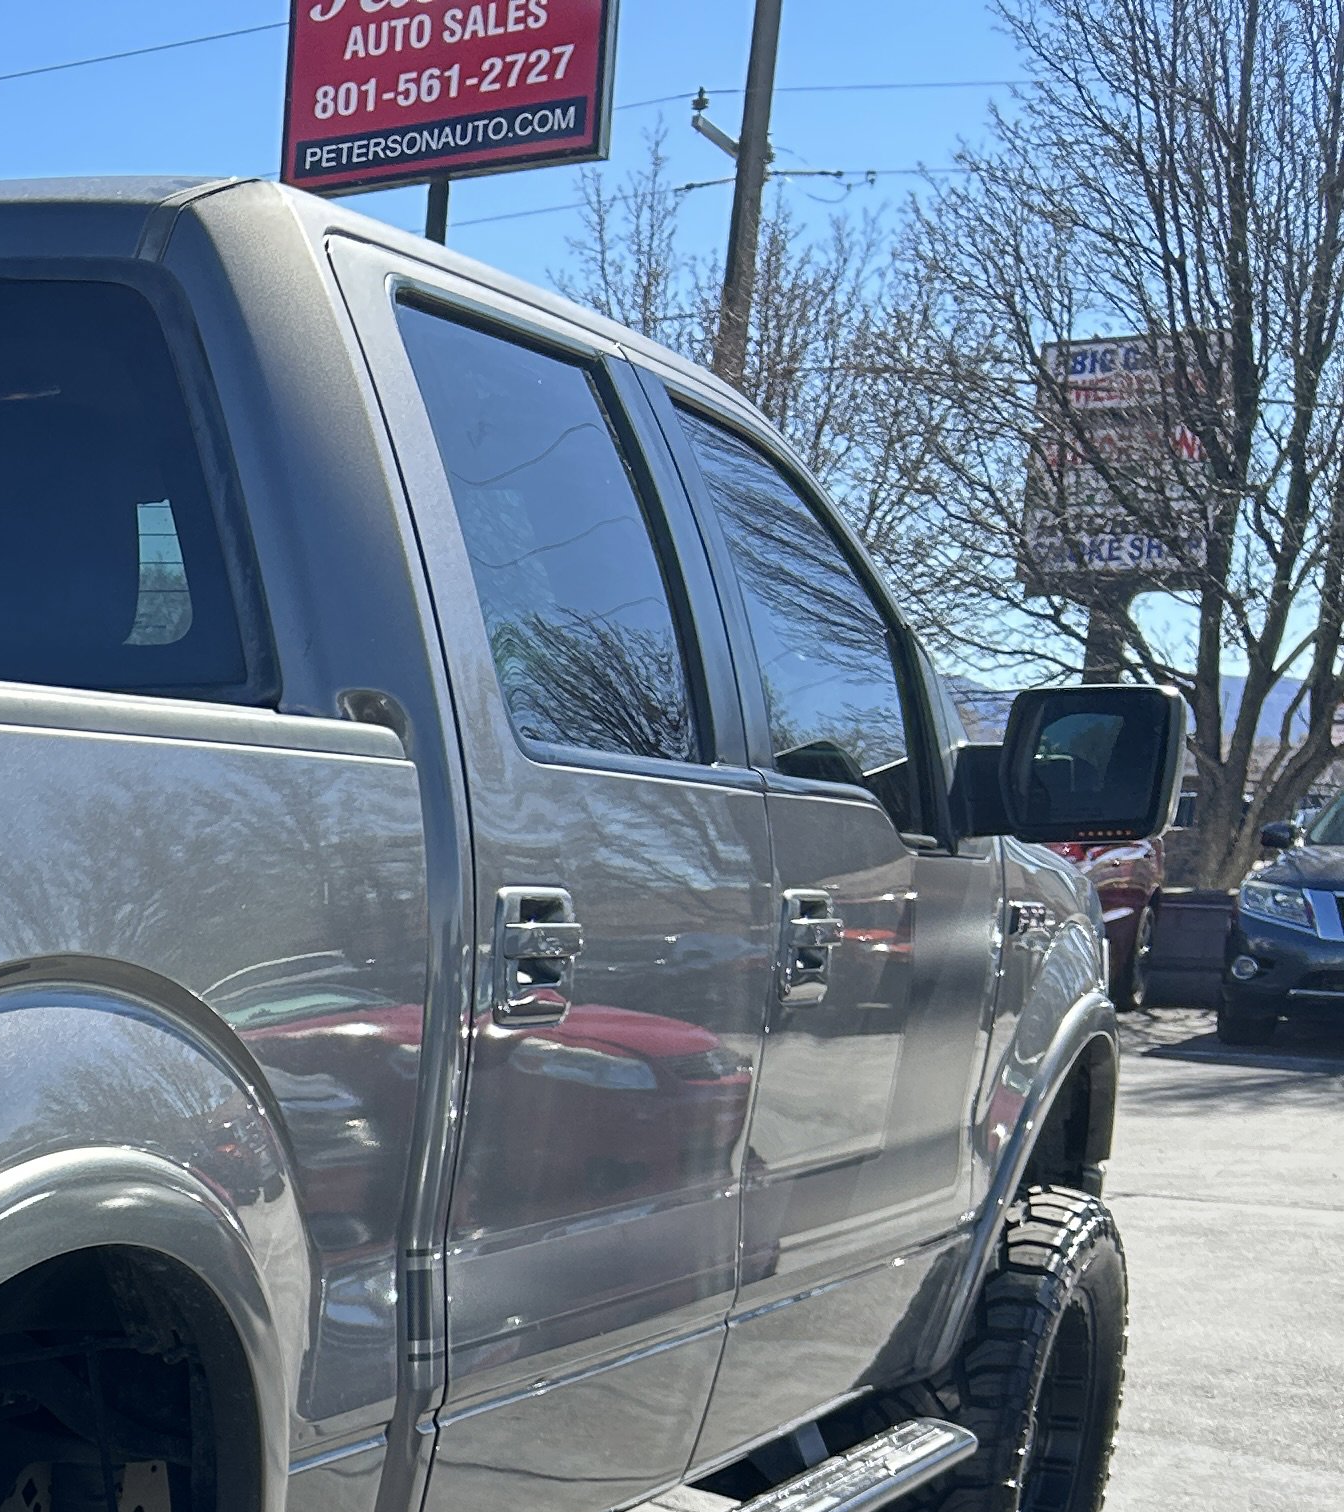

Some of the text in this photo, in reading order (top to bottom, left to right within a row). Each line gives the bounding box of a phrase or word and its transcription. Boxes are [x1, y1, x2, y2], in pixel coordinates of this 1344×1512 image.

[343, 13, 432, 60] AUTO
[442, 0, 548, 44] SALES
[314, 44, 576, 120] 801-561-2727
[304, 105, 576, 170] PETERSONAUTO.COM
